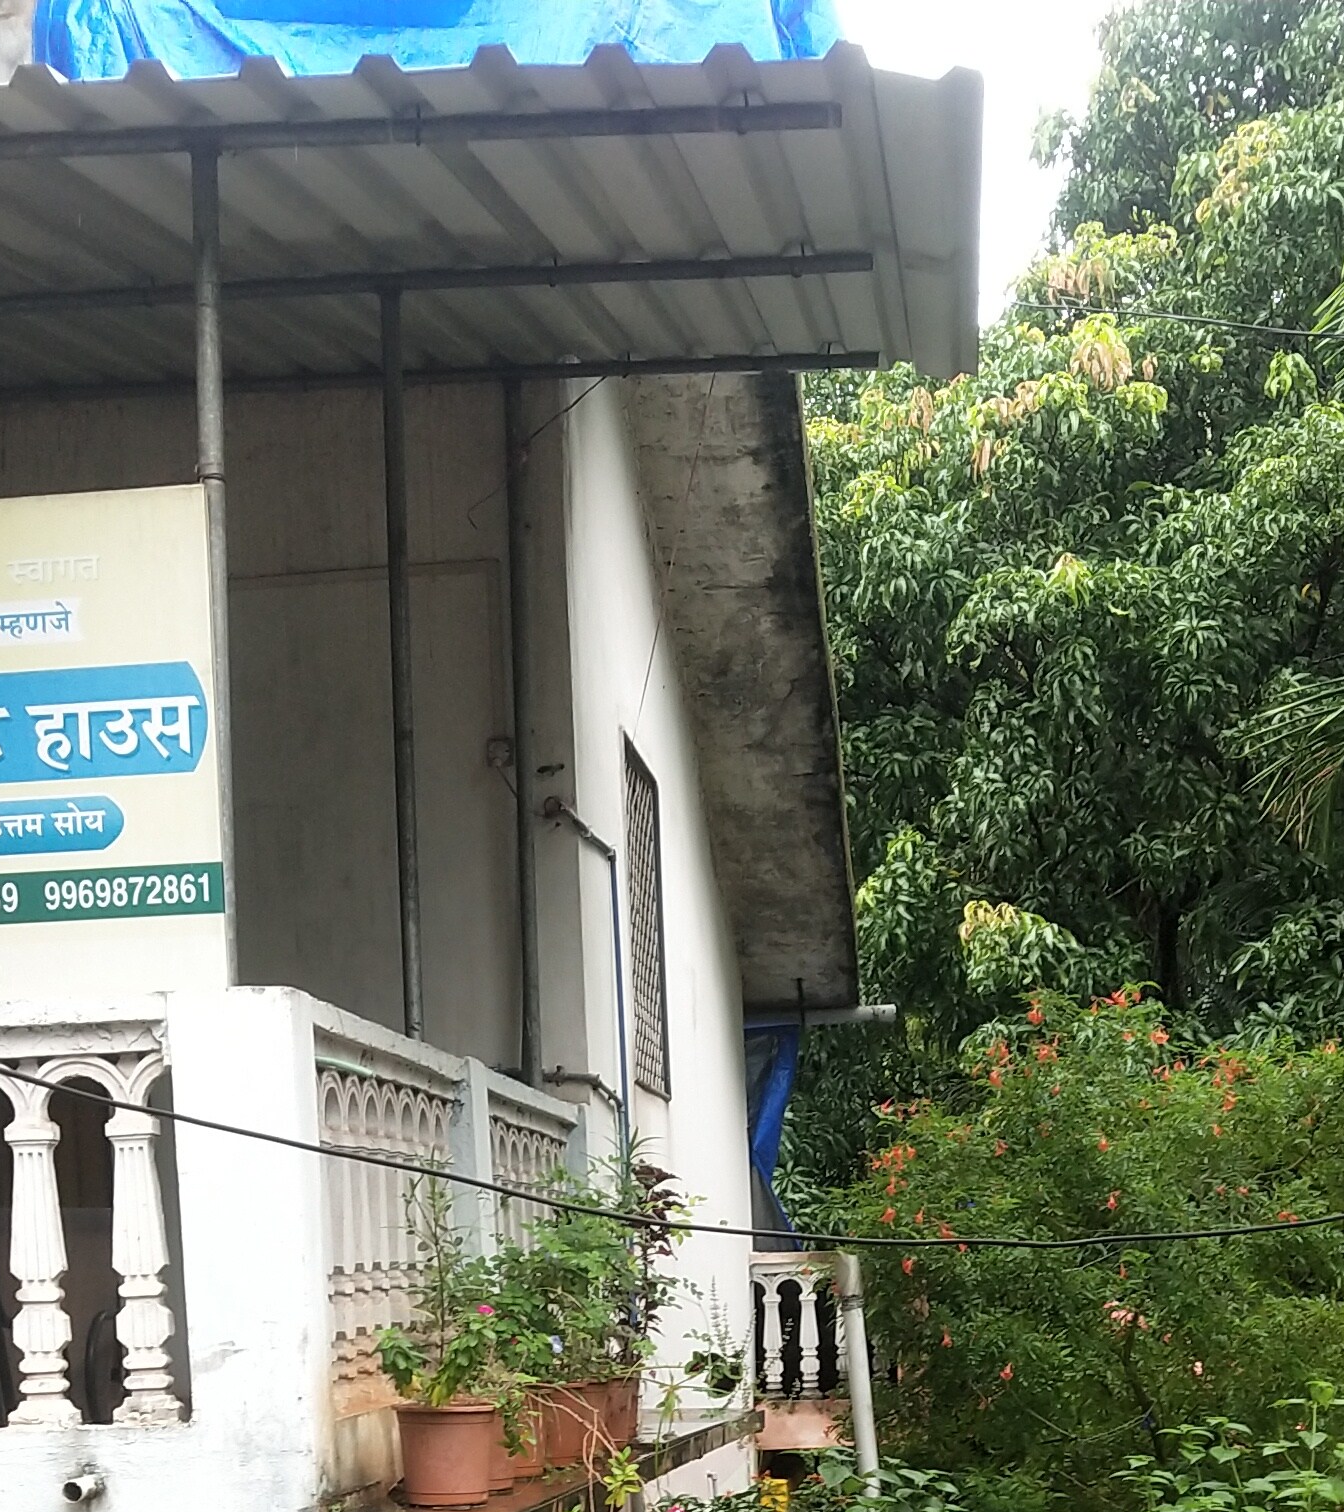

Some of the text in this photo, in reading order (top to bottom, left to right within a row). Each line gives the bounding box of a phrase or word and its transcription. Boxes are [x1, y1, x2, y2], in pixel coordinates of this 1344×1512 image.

[8, 553, 102, 584] स्वागत
[24, 695, 200, 772] हाउस
[50, 802, 107, 836] सोय
[43, 871, 211, 911] 9969872861
